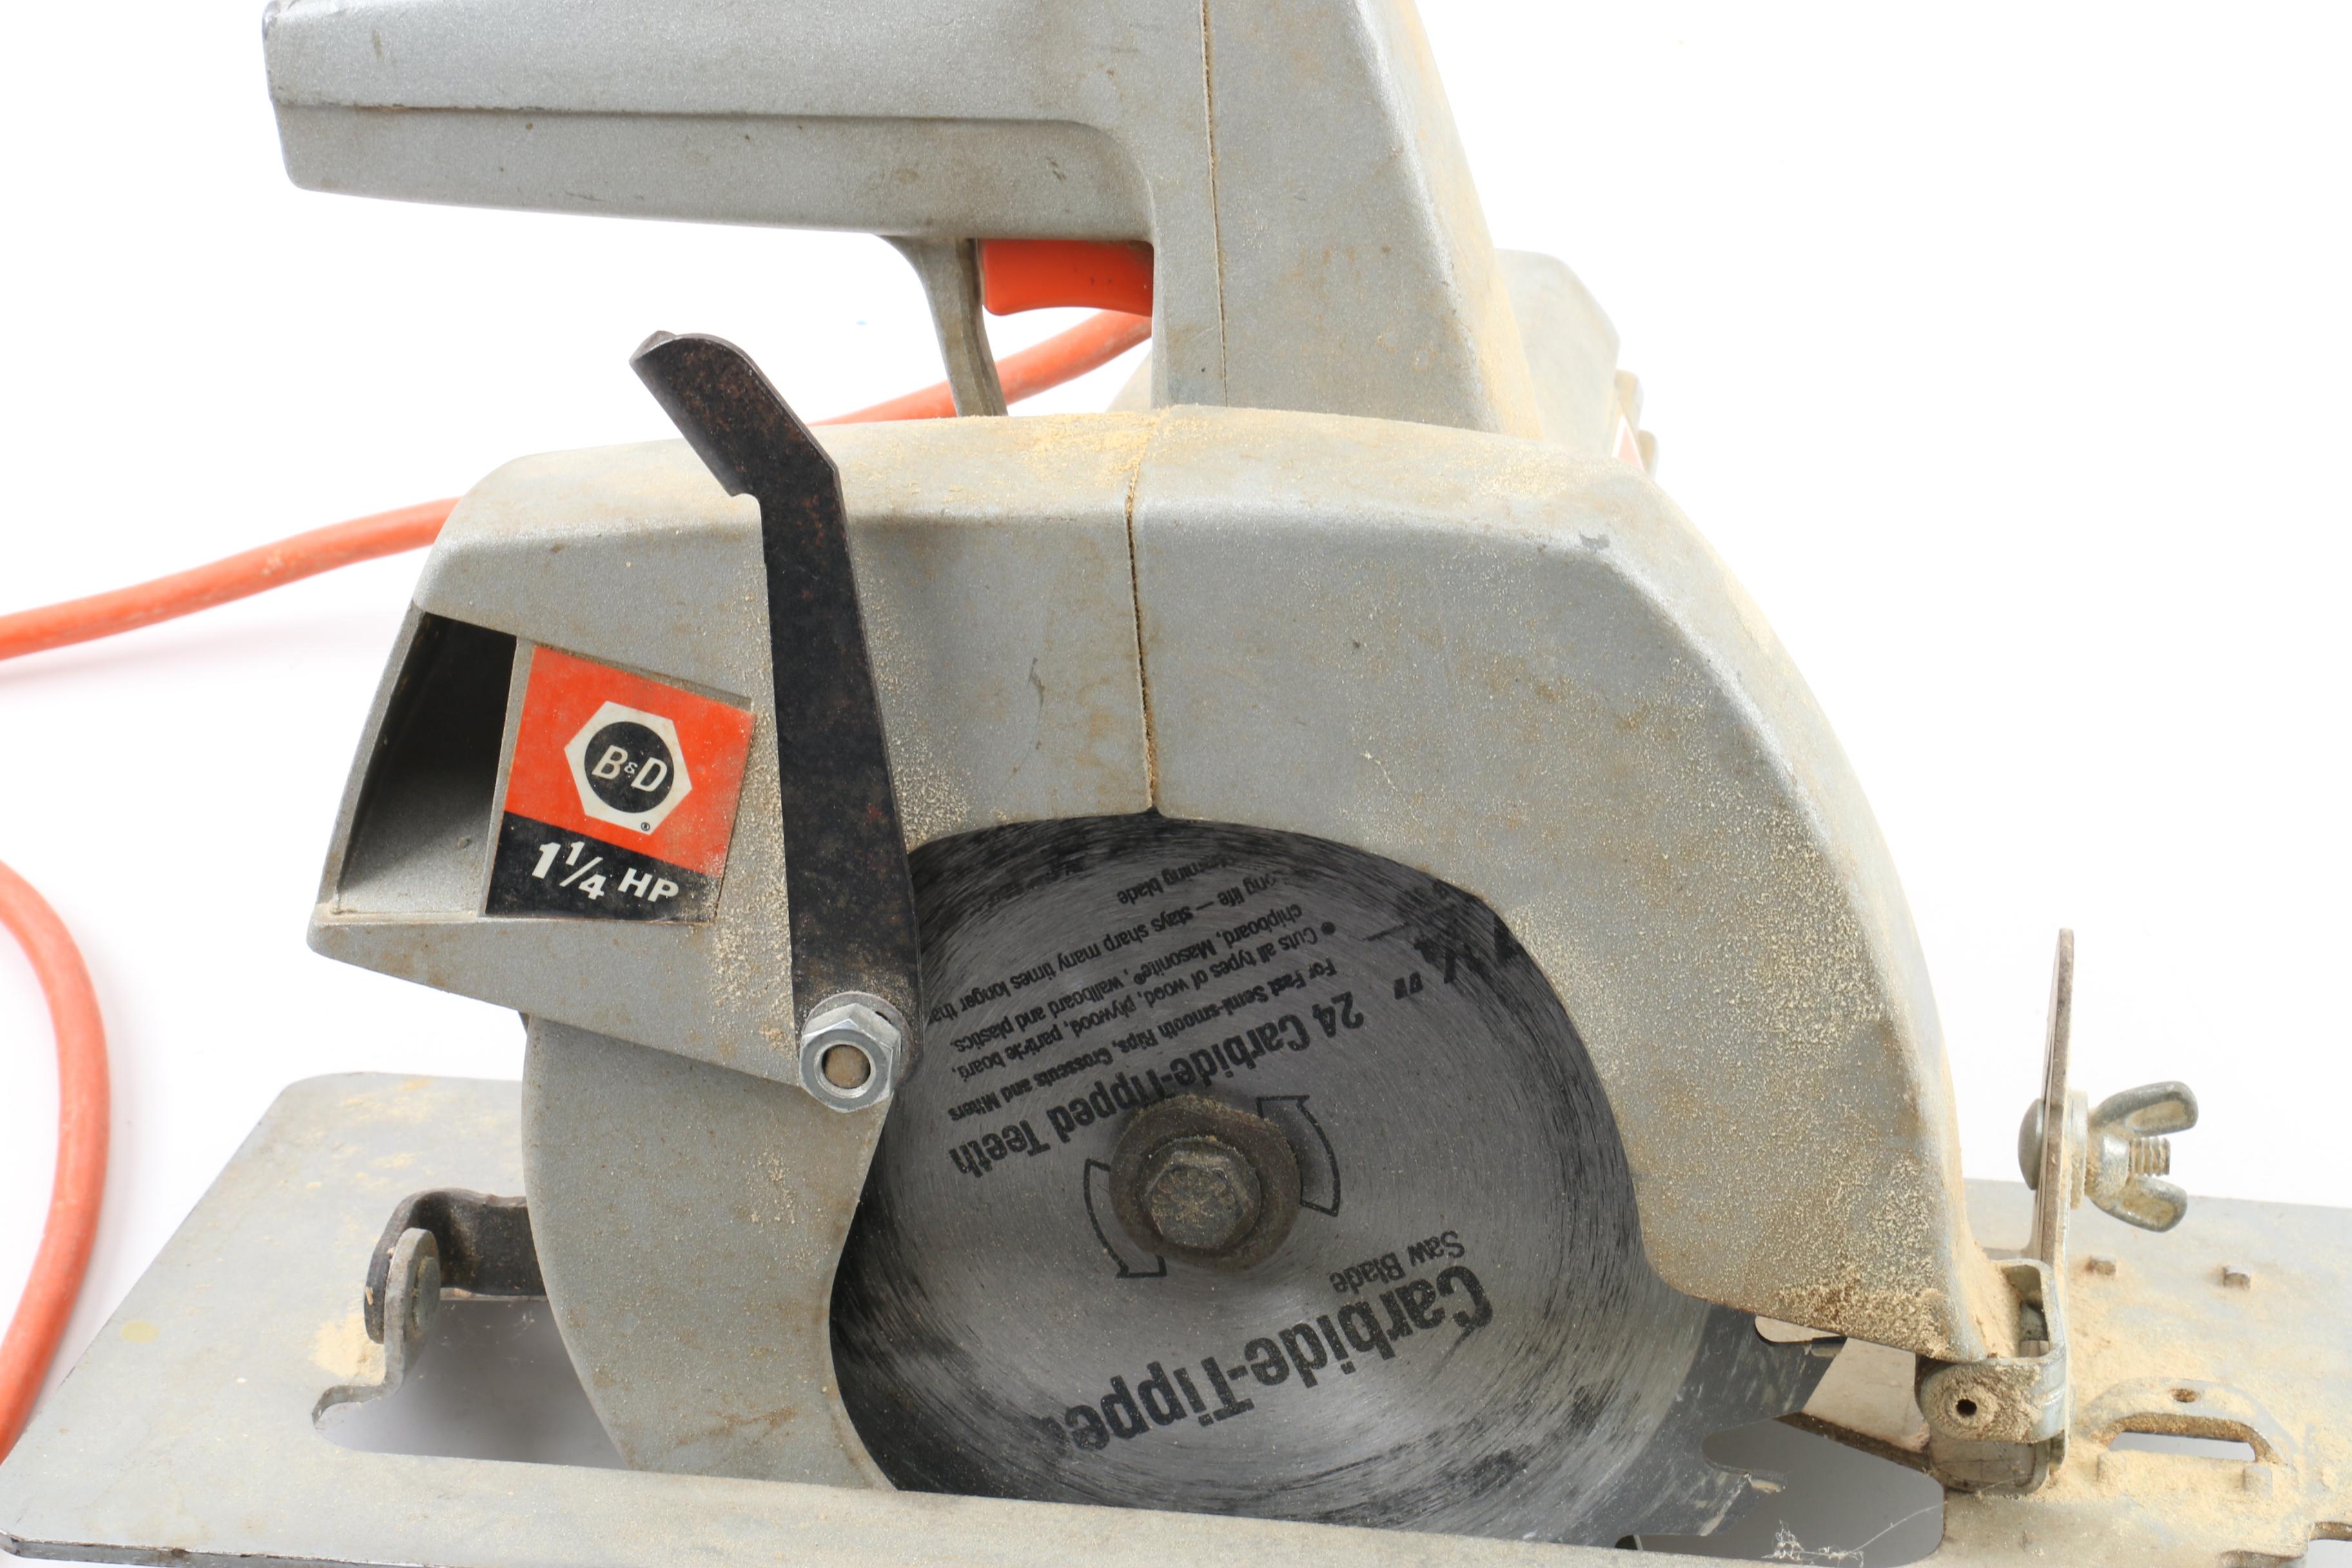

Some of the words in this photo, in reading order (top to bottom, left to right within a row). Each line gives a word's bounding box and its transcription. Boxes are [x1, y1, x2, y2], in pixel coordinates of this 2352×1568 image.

[592, 745, 668, 792] B&D
[617, 867, 680, 903] HP
[1117, 877, 1164, 904] blade
[1217, 887, 1244, 906] life
[1150, 905, 1193, 932] stays
[1215, 903, 1302, 948] chipboard,
[1102, 923, 1149, 952] sharp
[1256, 942, 1276, 963] all
[1277, 926, 1318, 950] Cuts
[1057, 943, 1102, 971] many
[1209, 949, 1257, 977] types
[1308, 958, 1337, 979] For
[1009, 962, 1056, 989] times
[1190, 969, 1208, 990] of
[1267, 970, 1306, 996] Fast
[959, 981, 1011, 1012] longer
[1047, 975, 1124, 1019] wallboard
[1137, 978, 1190, 1008] wood,
[1014, 1006, 1046, 1032] and
[1063, 994, 1136, 1038] plywood,
[1157, 985, 1269, 1039] Semi-smooth
[1311, 991, 1364, 1037] 24
[950, 1015, 1014, 1052] plastics.
[1004, 1023, 1063, 1060] particle
[1111, 1028, 1159, 1054] Rips,
[951, 1051, 1006, 1083] board,
[1033, 1047, 1113, 1086] Crosscuts
[1046, 1014, 1310, 1143] Carbide-Tipped
[999, 1078, 1032, 1102] and
[947, 1092, 1001, 1121] Miters
[948, 1120, 1050, 1178] Teeth
[1407, 1230, 1465, 1266] Saw
[1329, 1252, 1406, 1295] Blade
